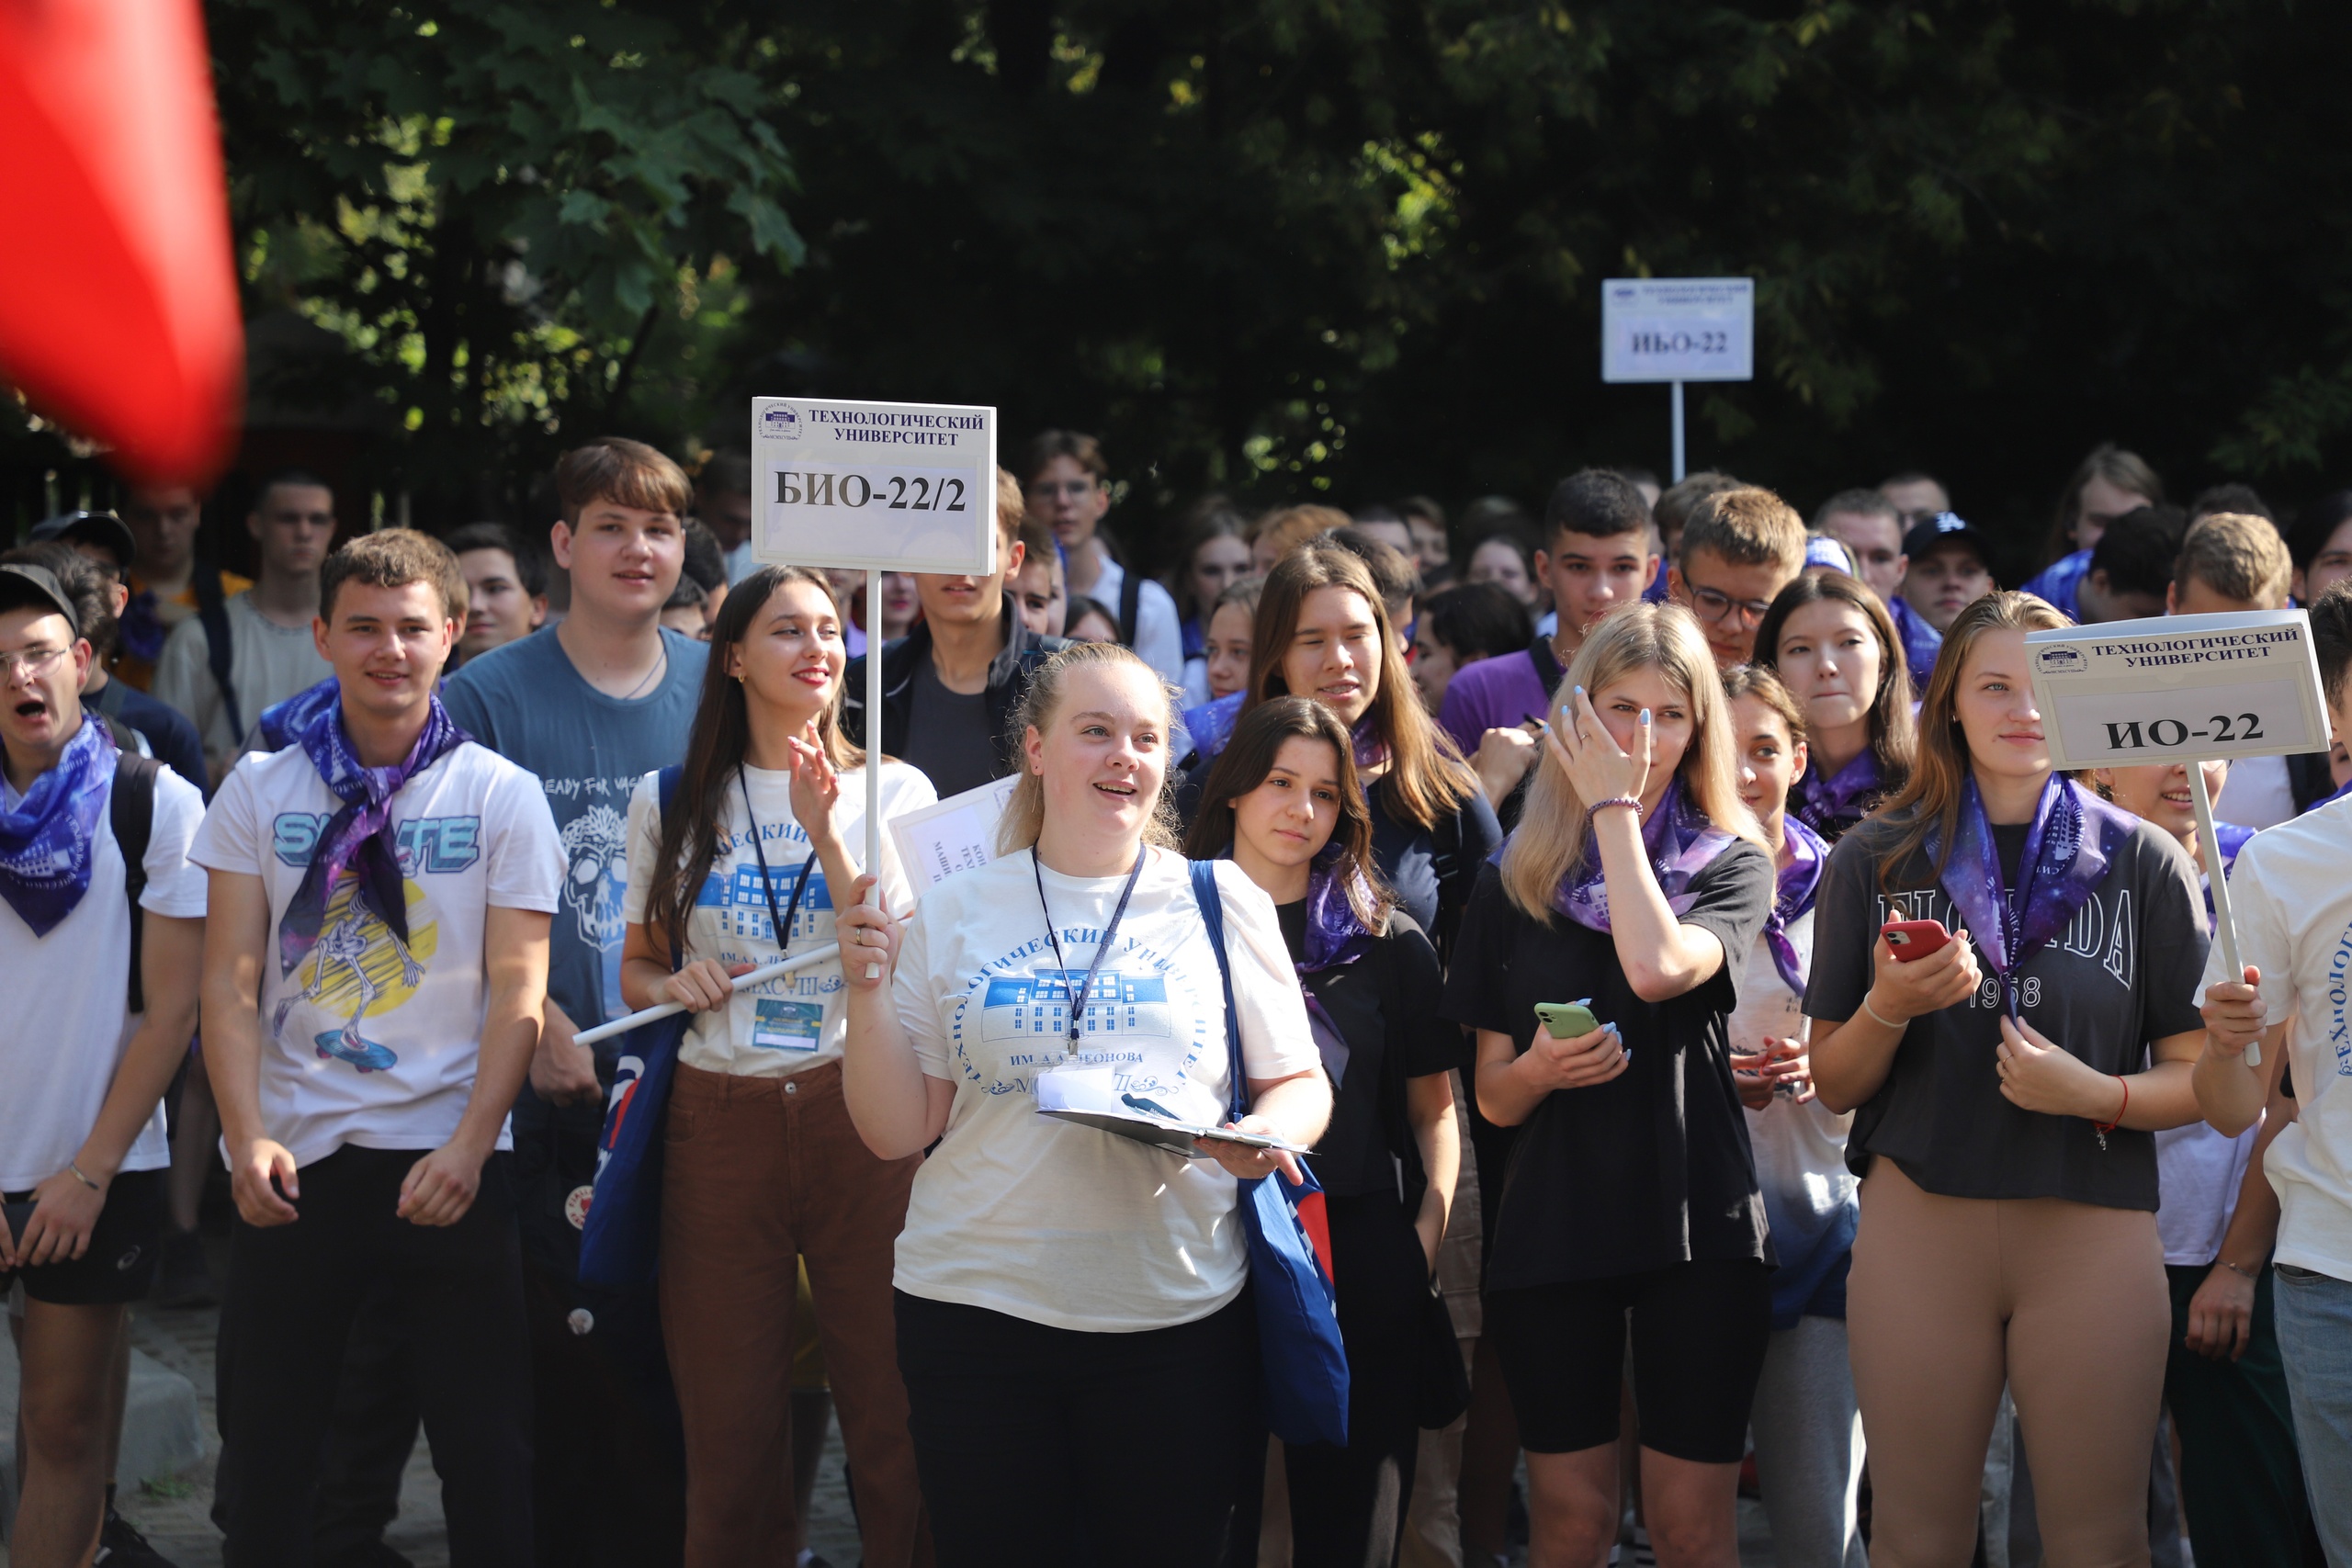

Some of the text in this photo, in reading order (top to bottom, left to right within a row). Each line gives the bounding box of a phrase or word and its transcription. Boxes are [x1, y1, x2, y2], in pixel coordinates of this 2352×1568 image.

[808, 409, 984, 430] ТЕХНОЛОГИЧЕСКИЙ
[834, 428, 959, 446] УНИВЕРСИТЕТ
[774, 470, 966, 512] БИО-22/2
[2092, 628, 2299, 657] ТЕХНОЛОГИЧЕСКИЙ
[2124, 647, 2272, 668] УНИВЕРСИТЕТ
[2101, 713, 2264, 750] ИО-22
[540, 778, 581, 801] EADY
[273, 812, 481, 874] STE
